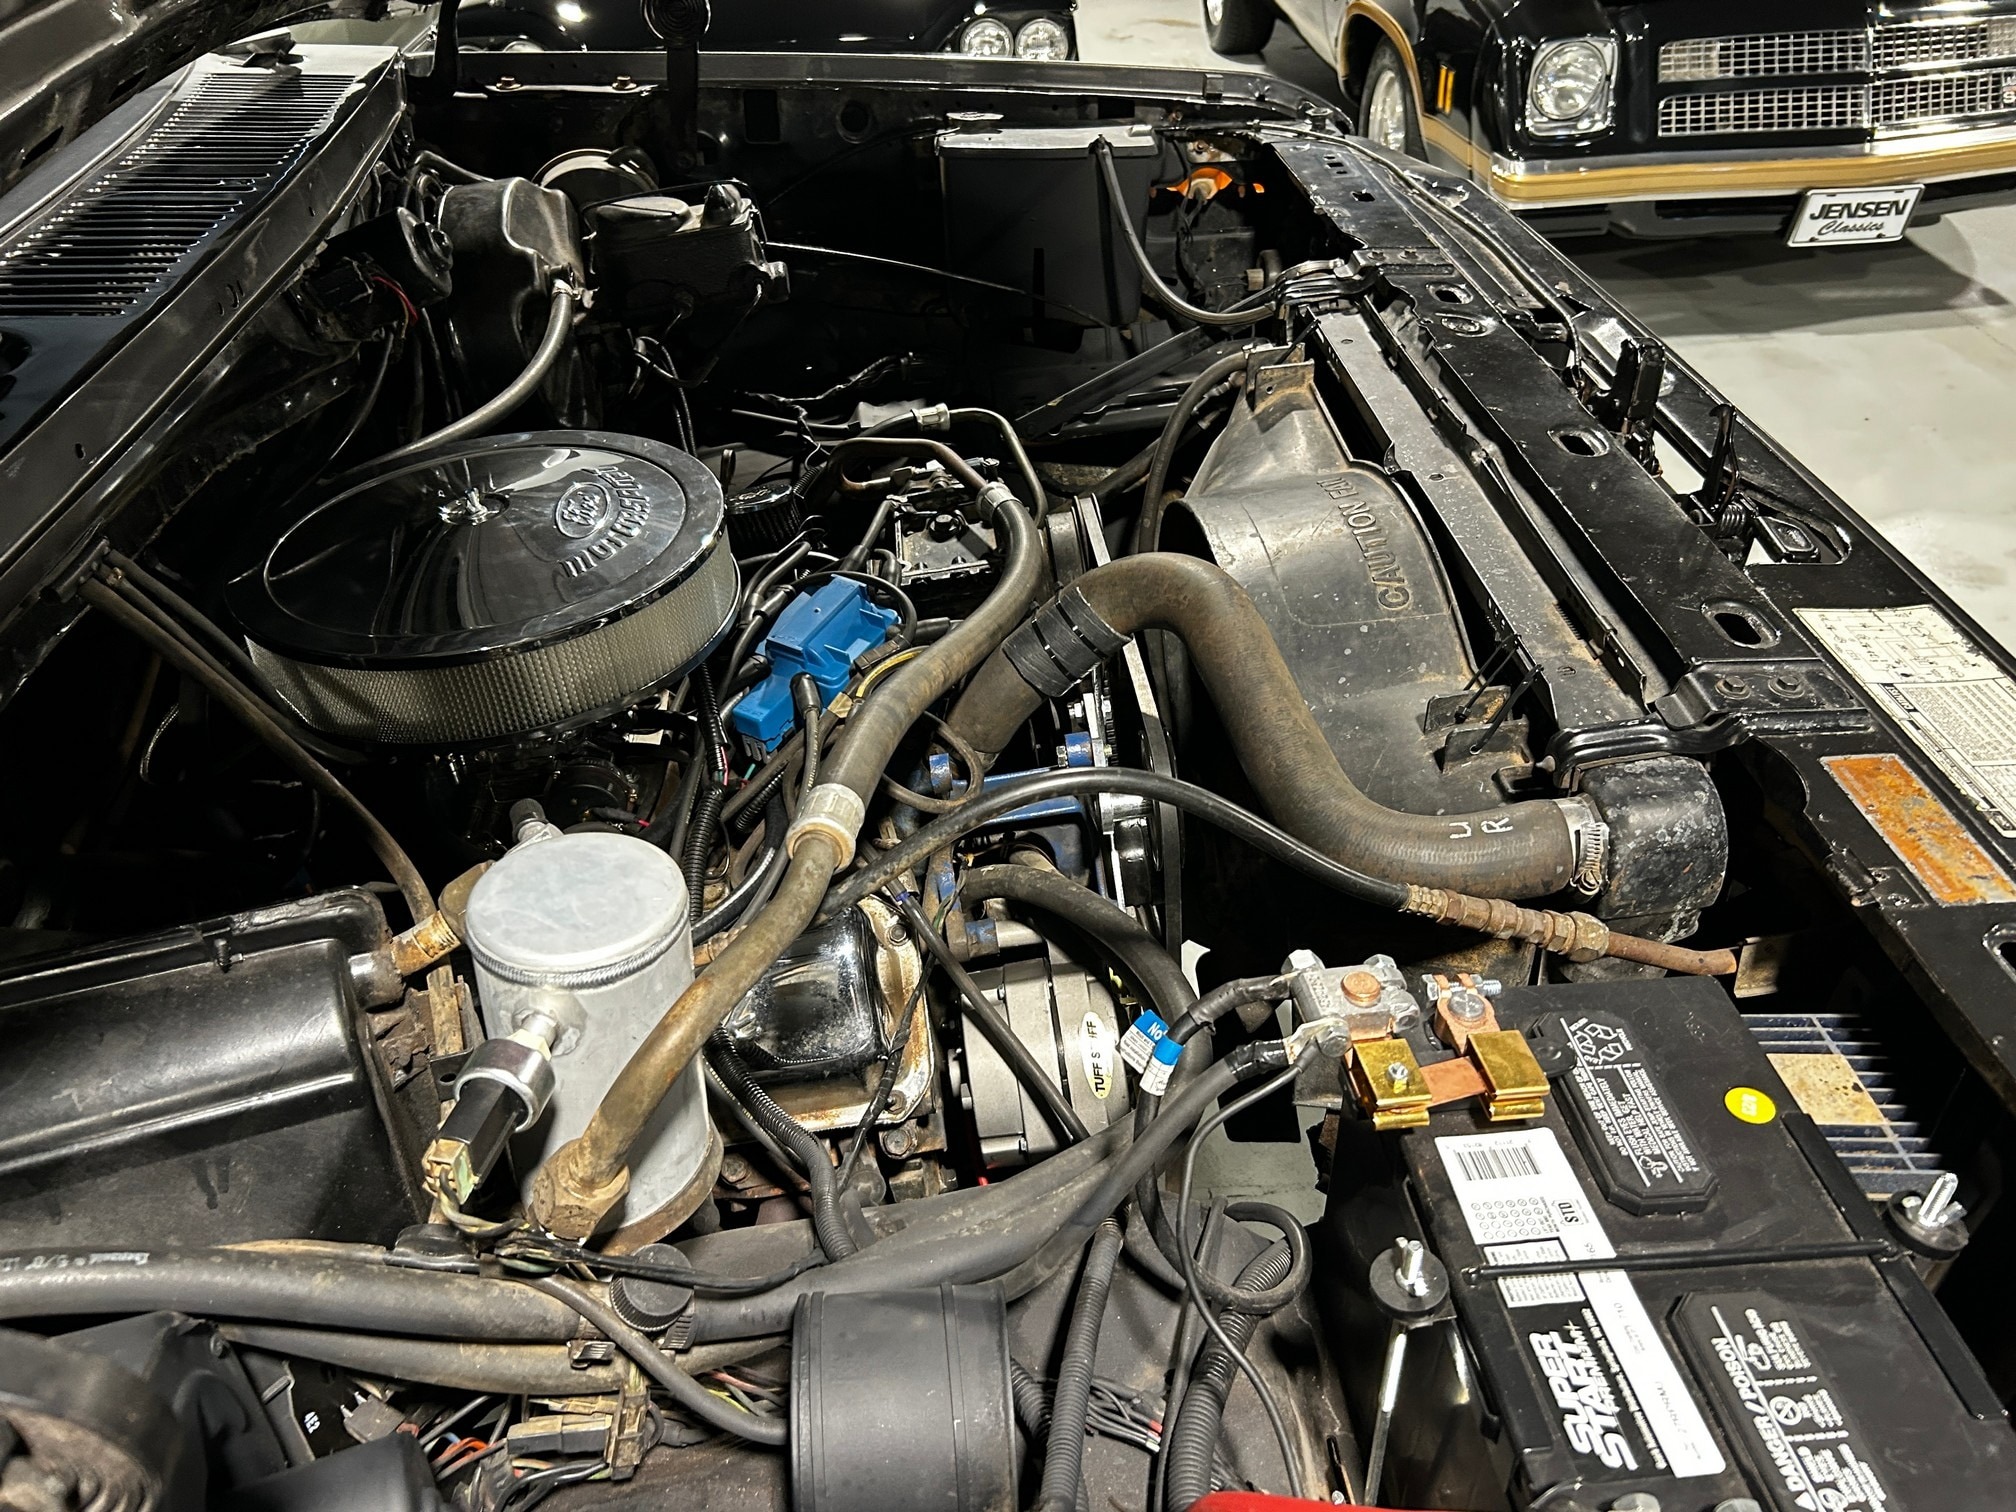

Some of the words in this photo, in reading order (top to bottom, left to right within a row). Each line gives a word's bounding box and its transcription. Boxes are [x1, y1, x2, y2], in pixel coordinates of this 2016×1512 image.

[1810, 199, 1911, 220] JENSEN
[1818, 220, 1885, 236] Classics
[561, 491, 601, 526] Ford
[1338, 501, 1412, 610] CAUTION
[1886, 685, 1915, 710] CATALYST
[1092, 1062, 1106, 1093] TUFF
[1597, 1078, 1623, 1117] IMMEDIATELY
[1618, 1101, 1630, 1114] GET
[1623, 1094, 1637, 1109] FAST
[1618, 1118, 1632, 1134] EYES
[1632, 1111, 1646, 1126] HELP
[1627, 1135, 1643, 1156] FLUSH
[1638, 1139, 1652, 1155] WITH
[1642, 1128, 1661, 1155] MEDICAL
[1558, 1201, 1579, 1223] STD
[1528, 1330, 1593, 1455] SUPER
[1548, 1330, 1640, 1471] START
